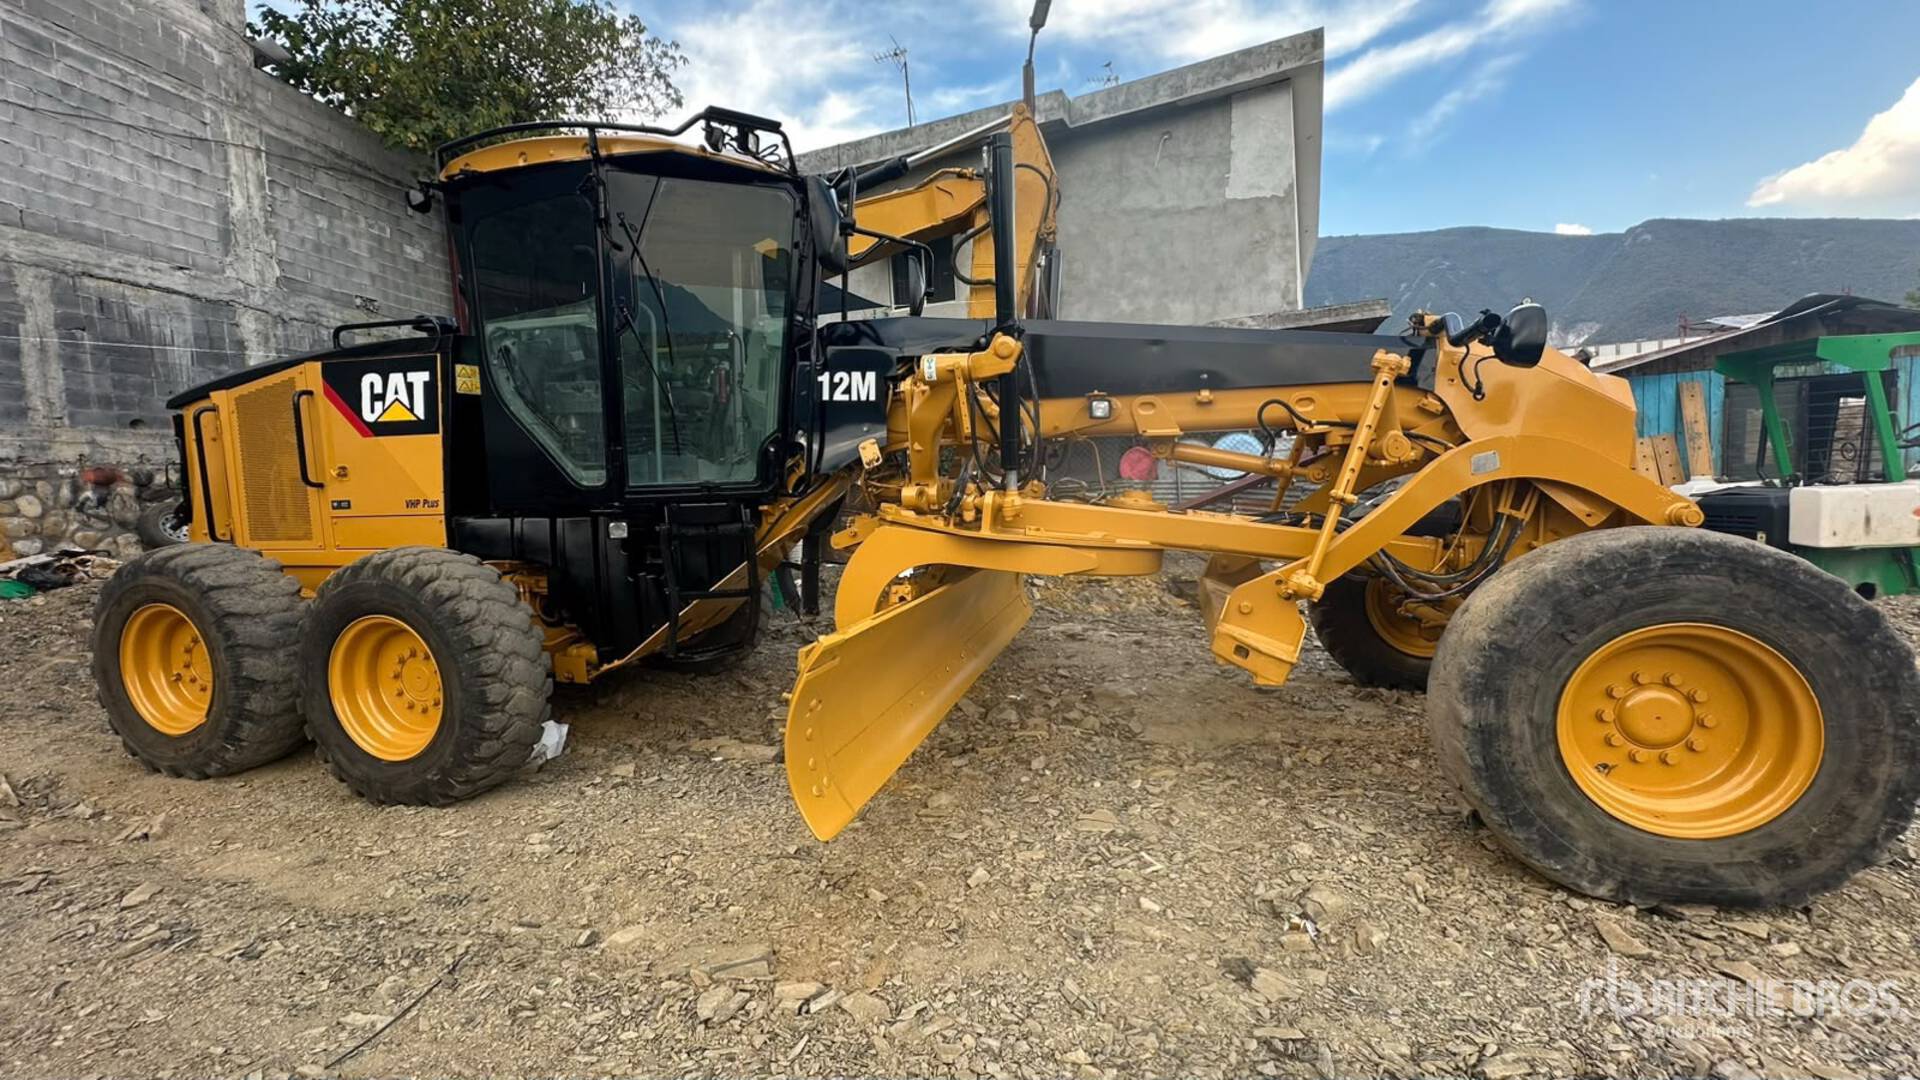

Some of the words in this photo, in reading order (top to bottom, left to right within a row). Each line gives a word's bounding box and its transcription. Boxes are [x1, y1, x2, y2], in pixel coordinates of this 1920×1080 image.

[361, 371, 430, 423] CAT
[817, 371, 876, 401] 12M
[405, 499, 420, 509] VHP
